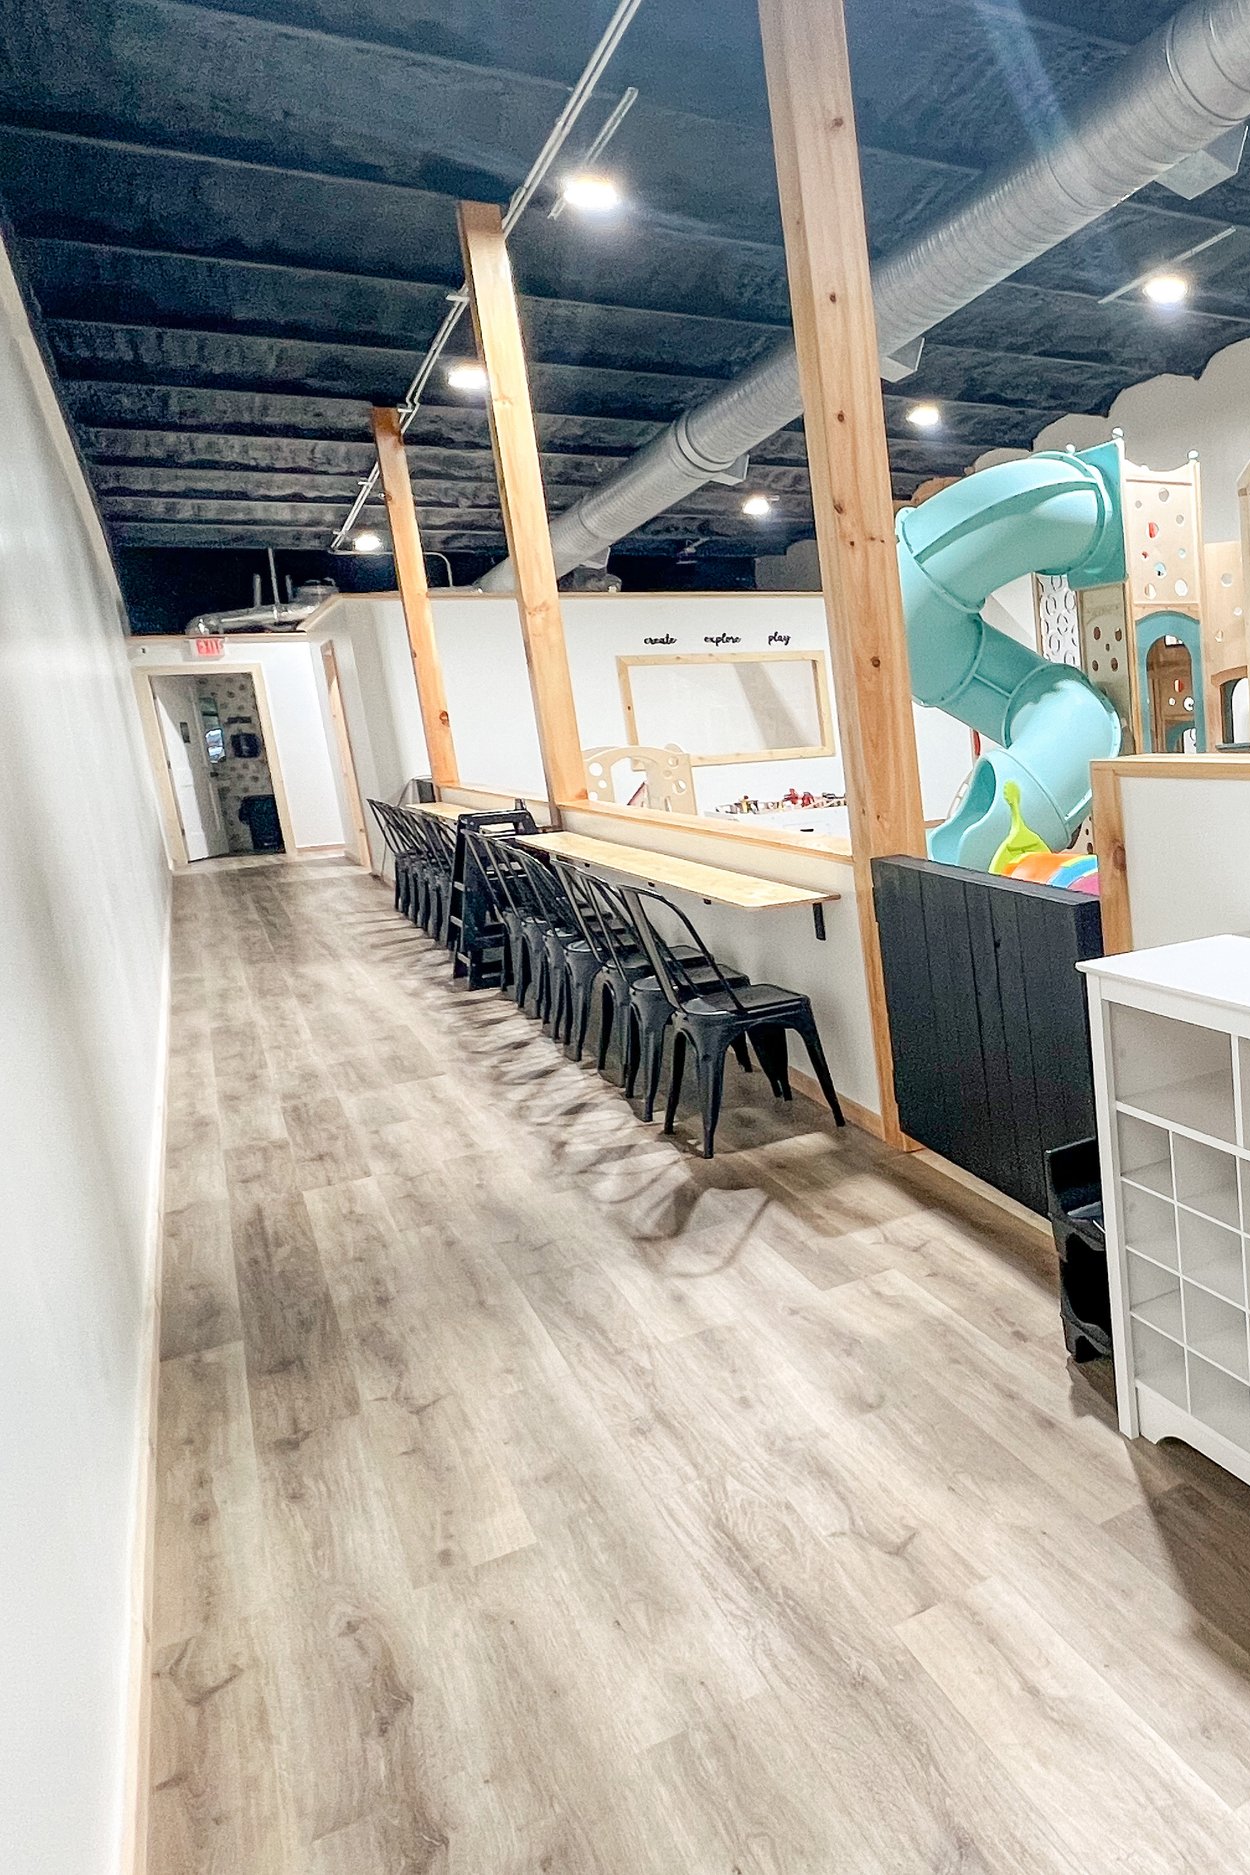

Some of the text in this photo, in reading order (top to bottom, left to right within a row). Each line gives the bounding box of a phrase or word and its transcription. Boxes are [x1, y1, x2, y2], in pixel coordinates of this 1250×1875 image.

[643, 631, 791, 646] create explore play
